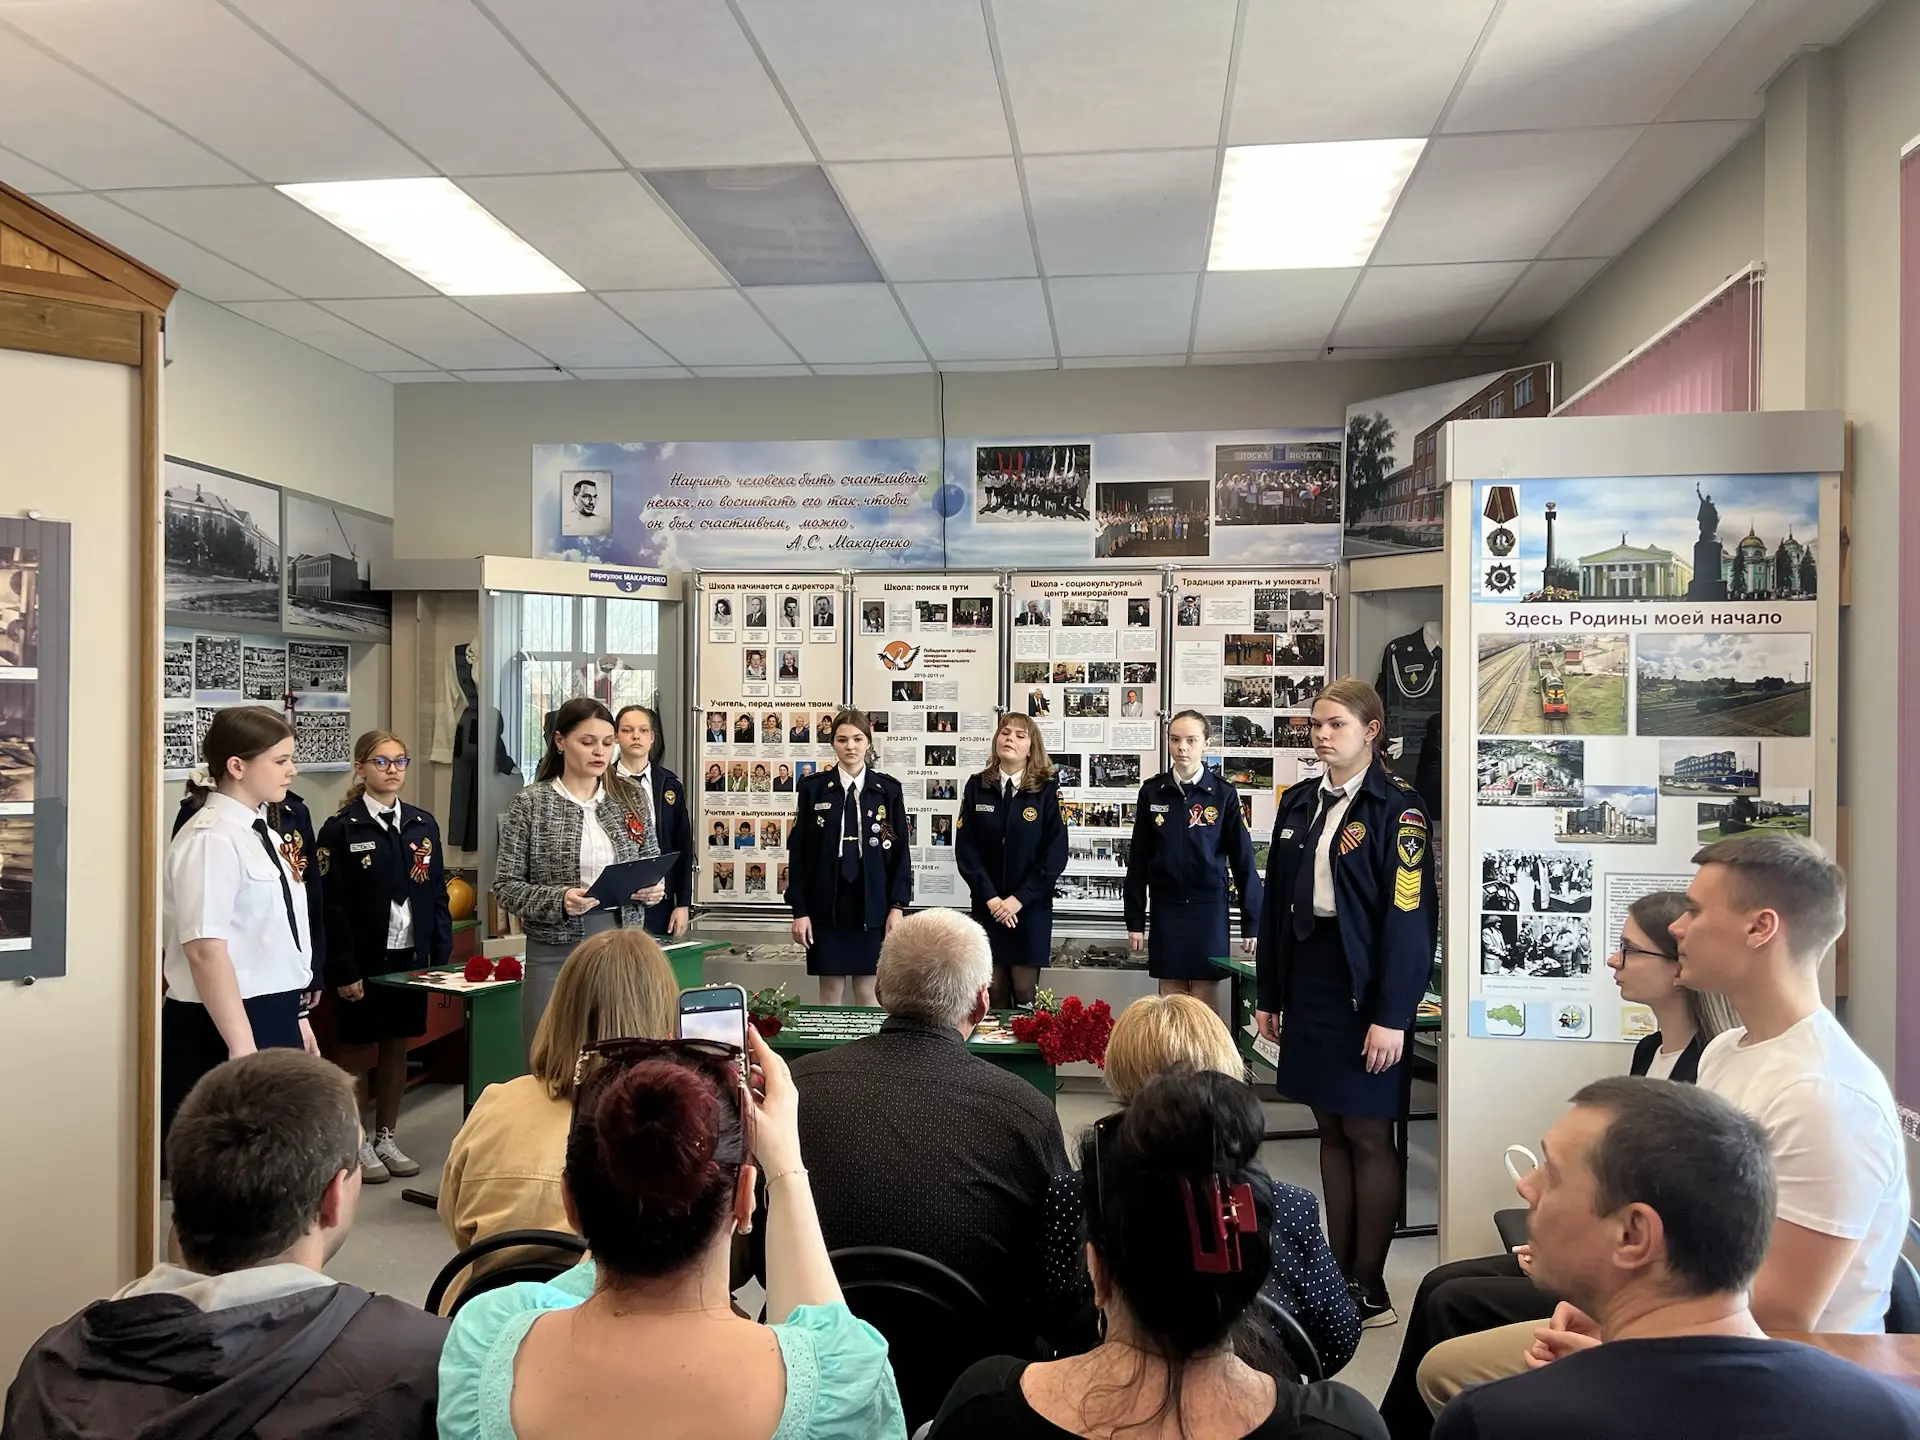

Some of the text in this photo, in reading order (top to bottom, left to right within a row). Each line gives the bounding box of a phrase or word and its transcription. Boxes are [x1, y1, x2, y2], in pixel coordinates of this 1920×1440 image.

[669, 471, 928, 492] Научить человека быть счастливым
[646, 492, 909, 511] нельзя, но воспитать его так, чтобы
[646, 519, 664, 529] он
[668, 516, 695, 529] был
[699, 516, 791, 530] счастливым,
[828, 533, 912, 553] Макаренко
[590, 572, 667, 584] переулок МАКАРЕНКО
[1030, 580, 1058, 588] Школа
[1065, 579, 1143, 588] социокультурный
[1182, 578, 1225, 587] Традиции
[1226, 579, 1263, 587] хранить
[1272, 577, 1321, 587] умножать!
[625, 581, 633, 592] 3
[708, 582, 735, 590] Школа
[791, 583, 835, 592] директора
[884, 583, 914, 591] Школа:
[949, 584, 969, 593] пути
[1044, 589, 1129, 598] центр микрорайона
[1505, 610, 1783, 627] Здесь Родины моей начало
[710, 699, 746, 708] Учитель,
[748, 700, 773, 709] перед
